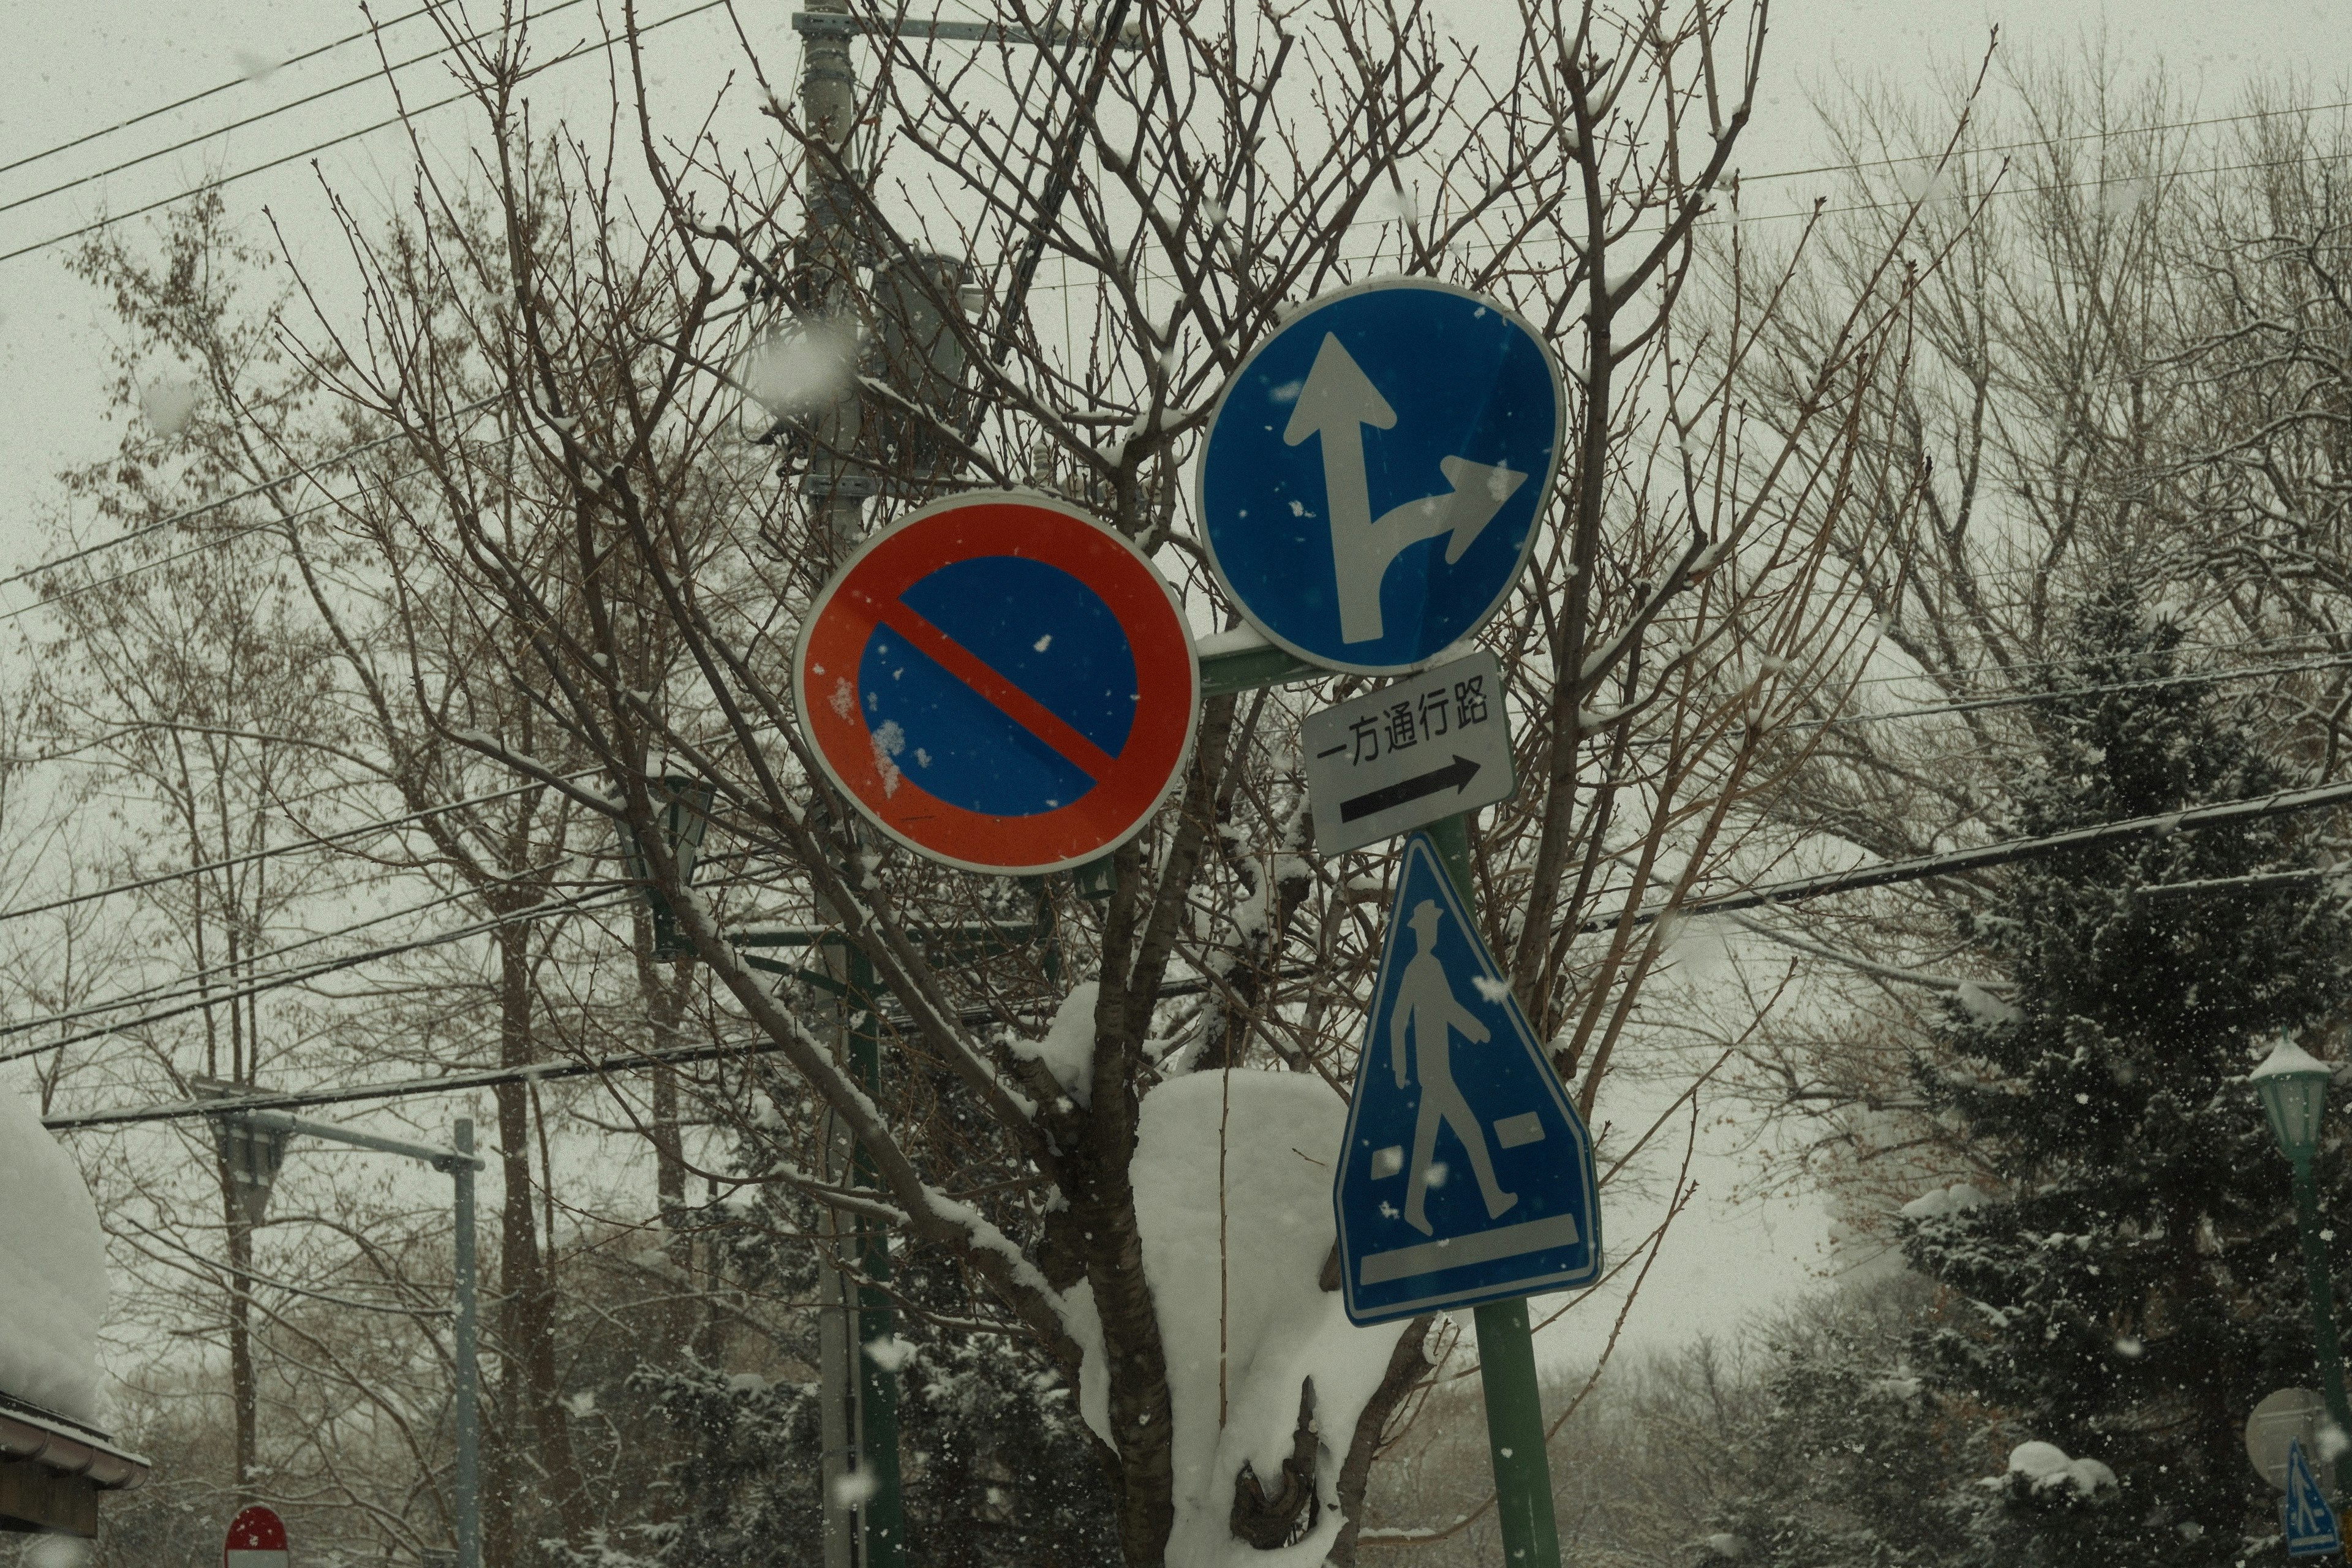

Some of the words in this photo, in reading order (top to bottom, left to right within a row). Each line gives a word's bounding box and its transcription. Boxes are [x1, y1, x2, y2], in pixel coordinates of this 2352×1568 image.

[1317, 675, 1488, 766] 一方通行路
